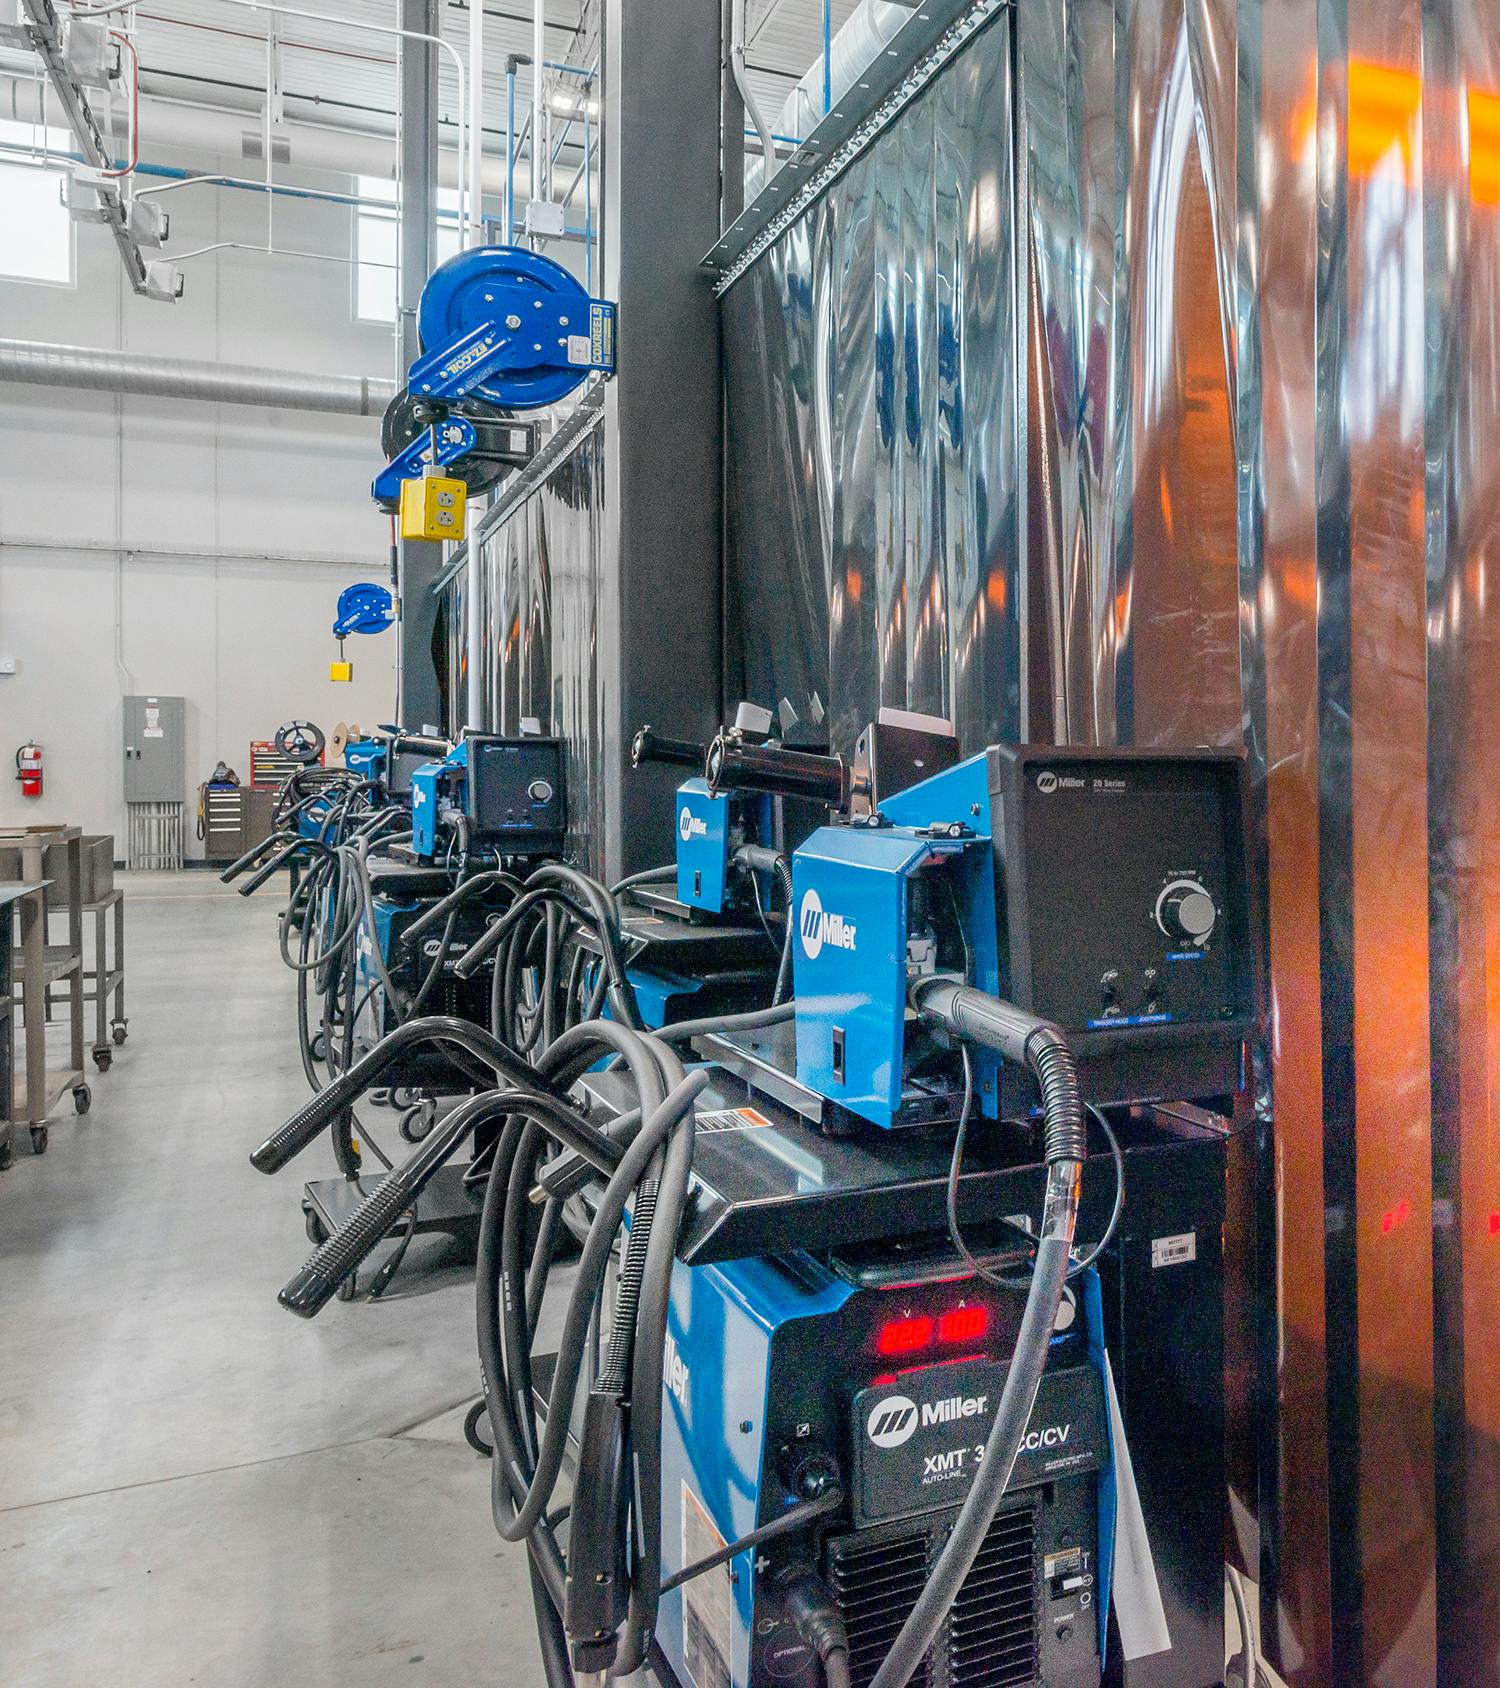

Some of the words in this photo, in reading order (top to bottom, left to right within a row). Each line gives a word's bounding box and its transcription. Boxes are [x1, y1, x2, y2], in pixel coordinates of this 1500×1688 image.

[592, 307, 602, 363] COXREELS
[1104, 779, 1126, 787] Series
[958, 1300, 966, 1308] A
[903, 1309, 911, 1318] V
[924, 1449, 967, 1475] XMT
